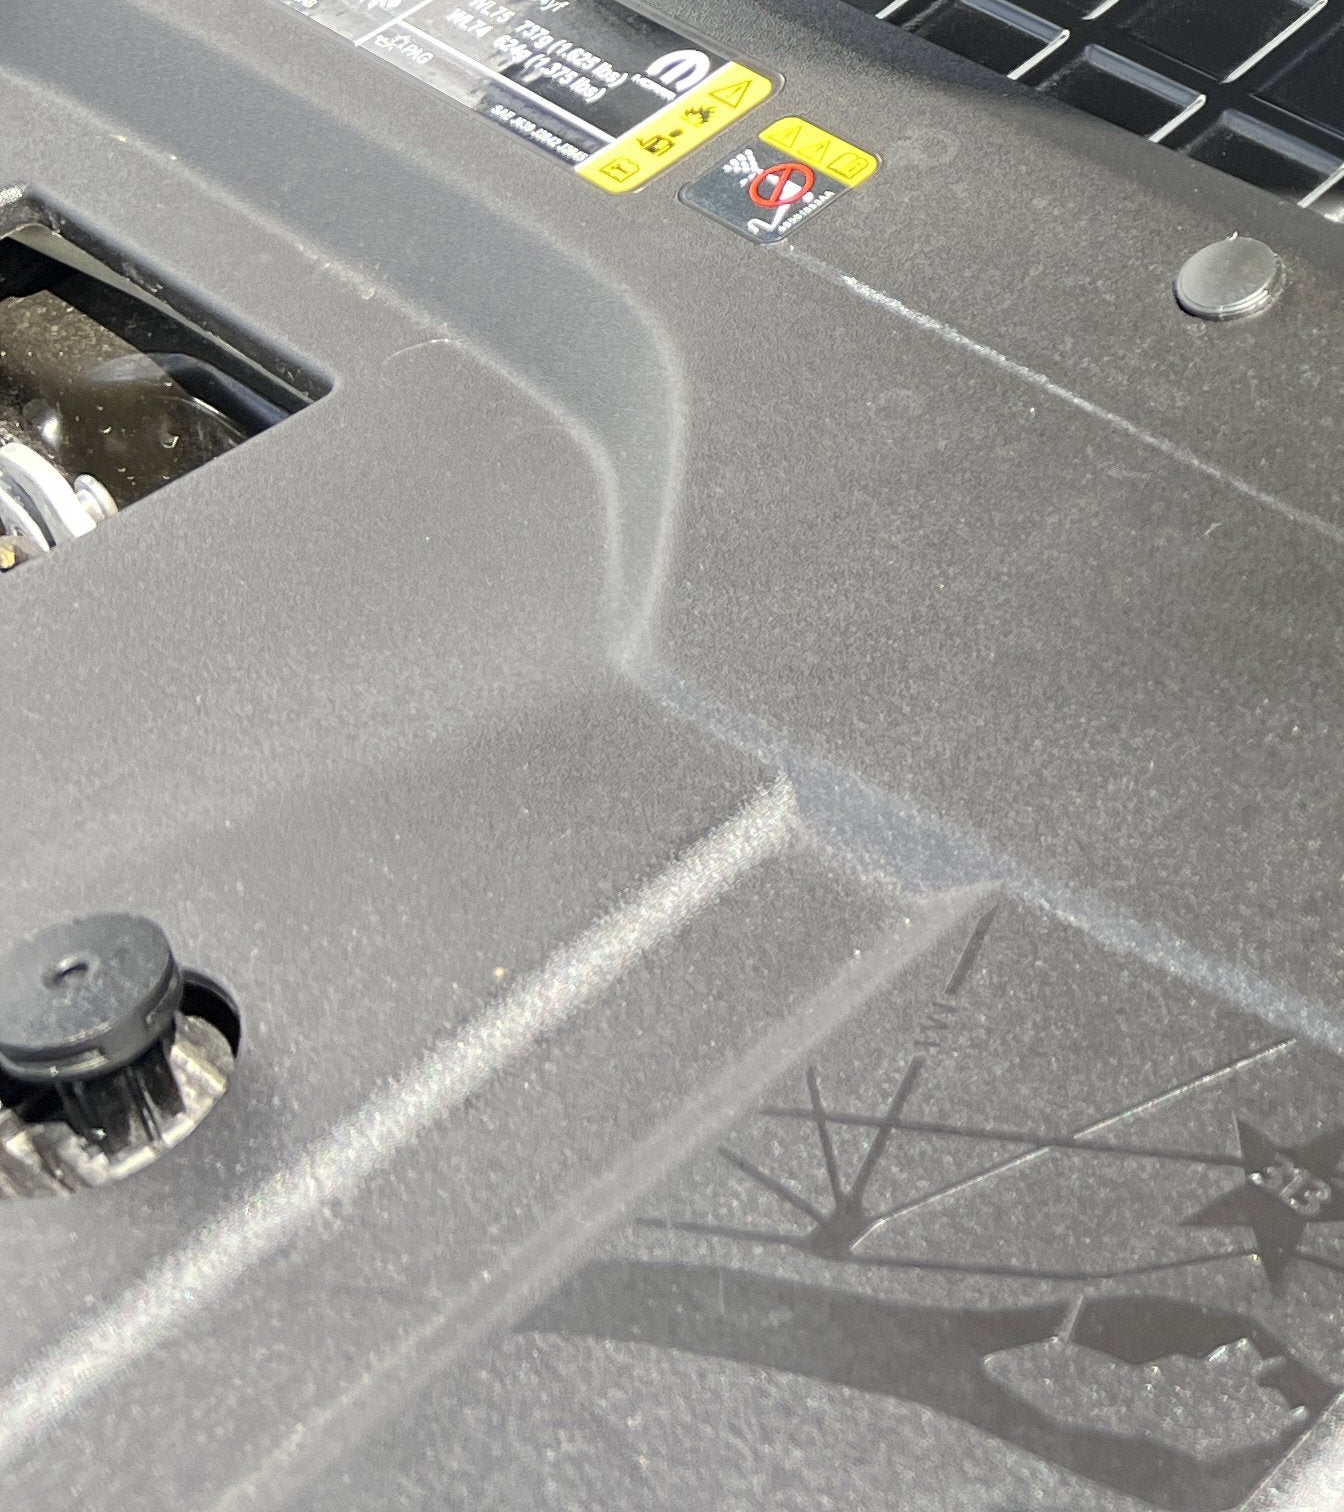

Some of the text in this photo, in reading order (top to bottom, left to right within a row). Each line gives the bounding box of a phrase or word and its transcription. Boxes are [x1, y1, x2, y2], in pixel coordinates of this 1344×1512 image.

[402, 40, 433, 64] PAG
[447, 8, 607, 104] WL74 624g (1.375 lbs)
[516, 19, 554, 49] 737g
[547, 39, 601, 70] (1.625
[592, 62, 629, 89] lbs)
[490, 104, 516, 120] SAE
